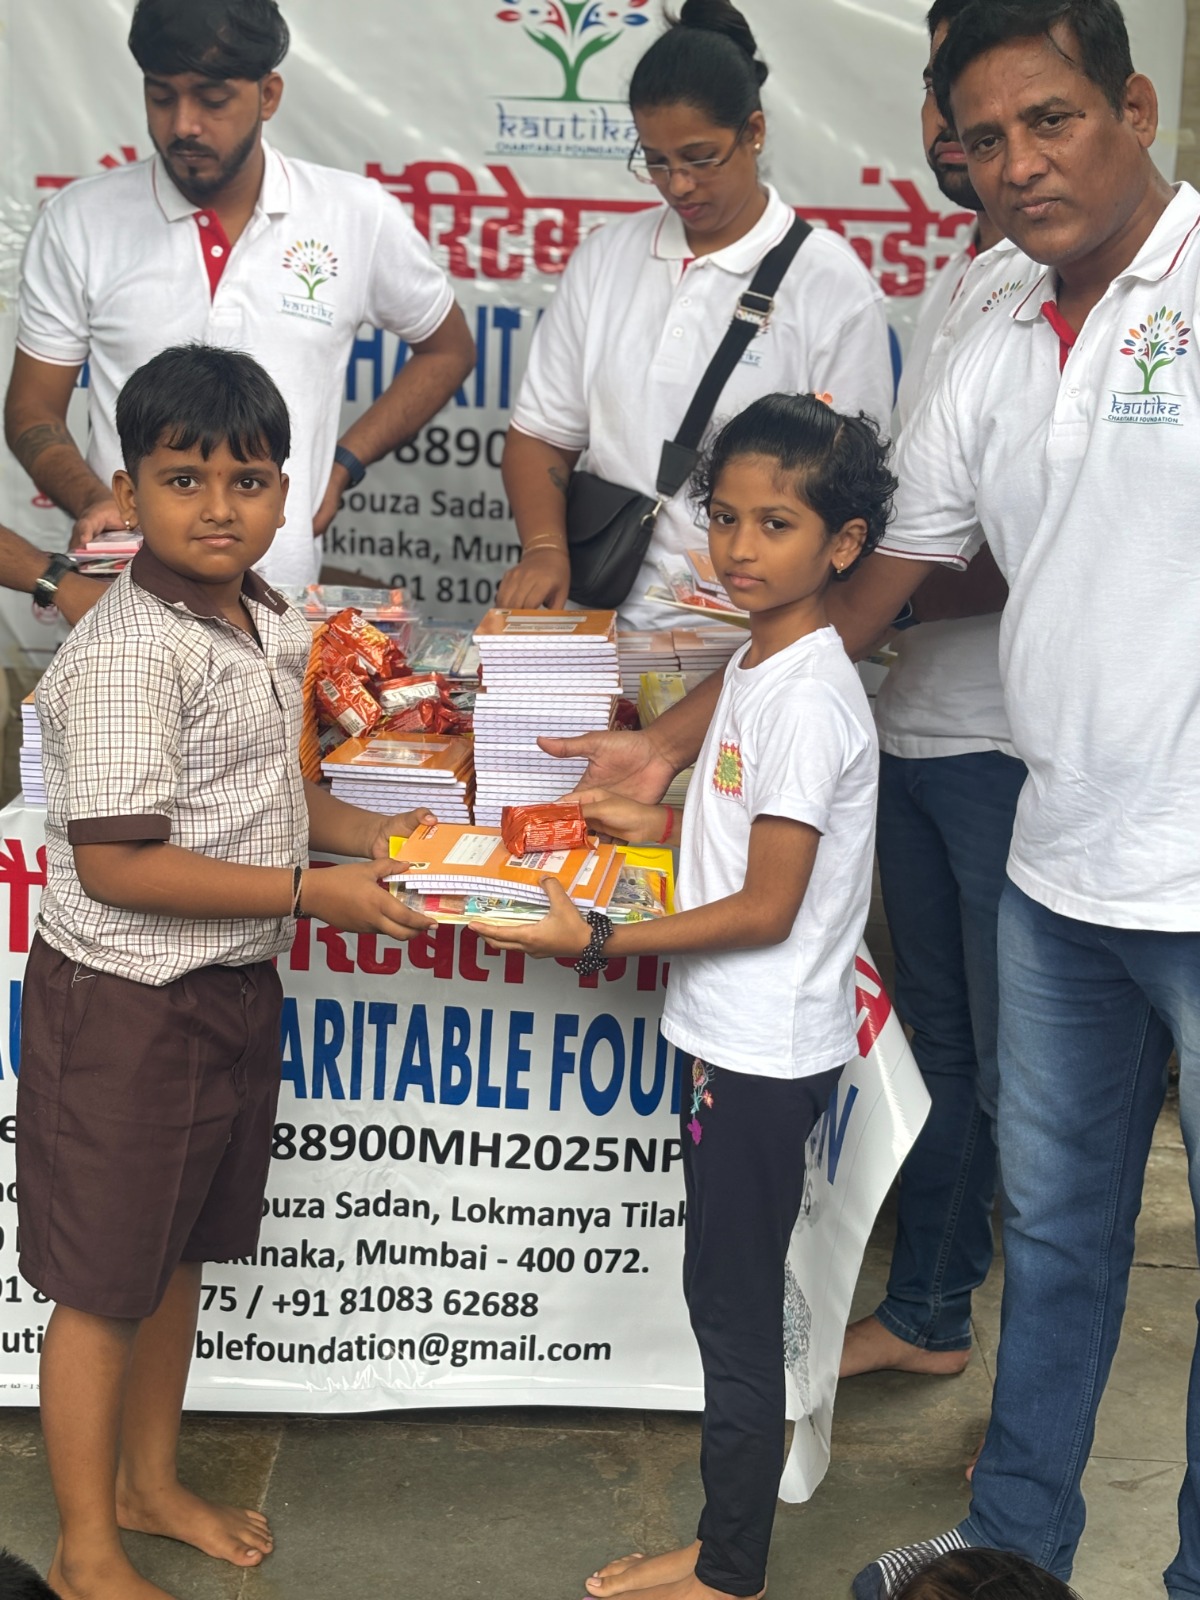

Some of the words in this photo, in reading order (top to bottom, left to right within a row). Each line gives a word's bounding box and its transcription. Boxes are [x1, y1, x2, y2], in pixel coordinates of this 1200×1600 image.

[323, 527, 440, 564] kinaka,
[437, 577, 503, 605] 810
[549, 1013, 682, 1117] FOU
[335, 1189, 440, 1226] Sadan,
[452, 1197, 610, 1233] Lokmanya
[356, 1239, 487, 1270] Mumbai
[517, 1247, 575, 1273] 400
[584, 1247, 649, 1274] 072.
[246, 1285, 264, 1319] /
[272, 1289, 329, 1317] +91
[340, 1286, 433, 1315] 81083
[443, 1290, 539, 1317] 62688
